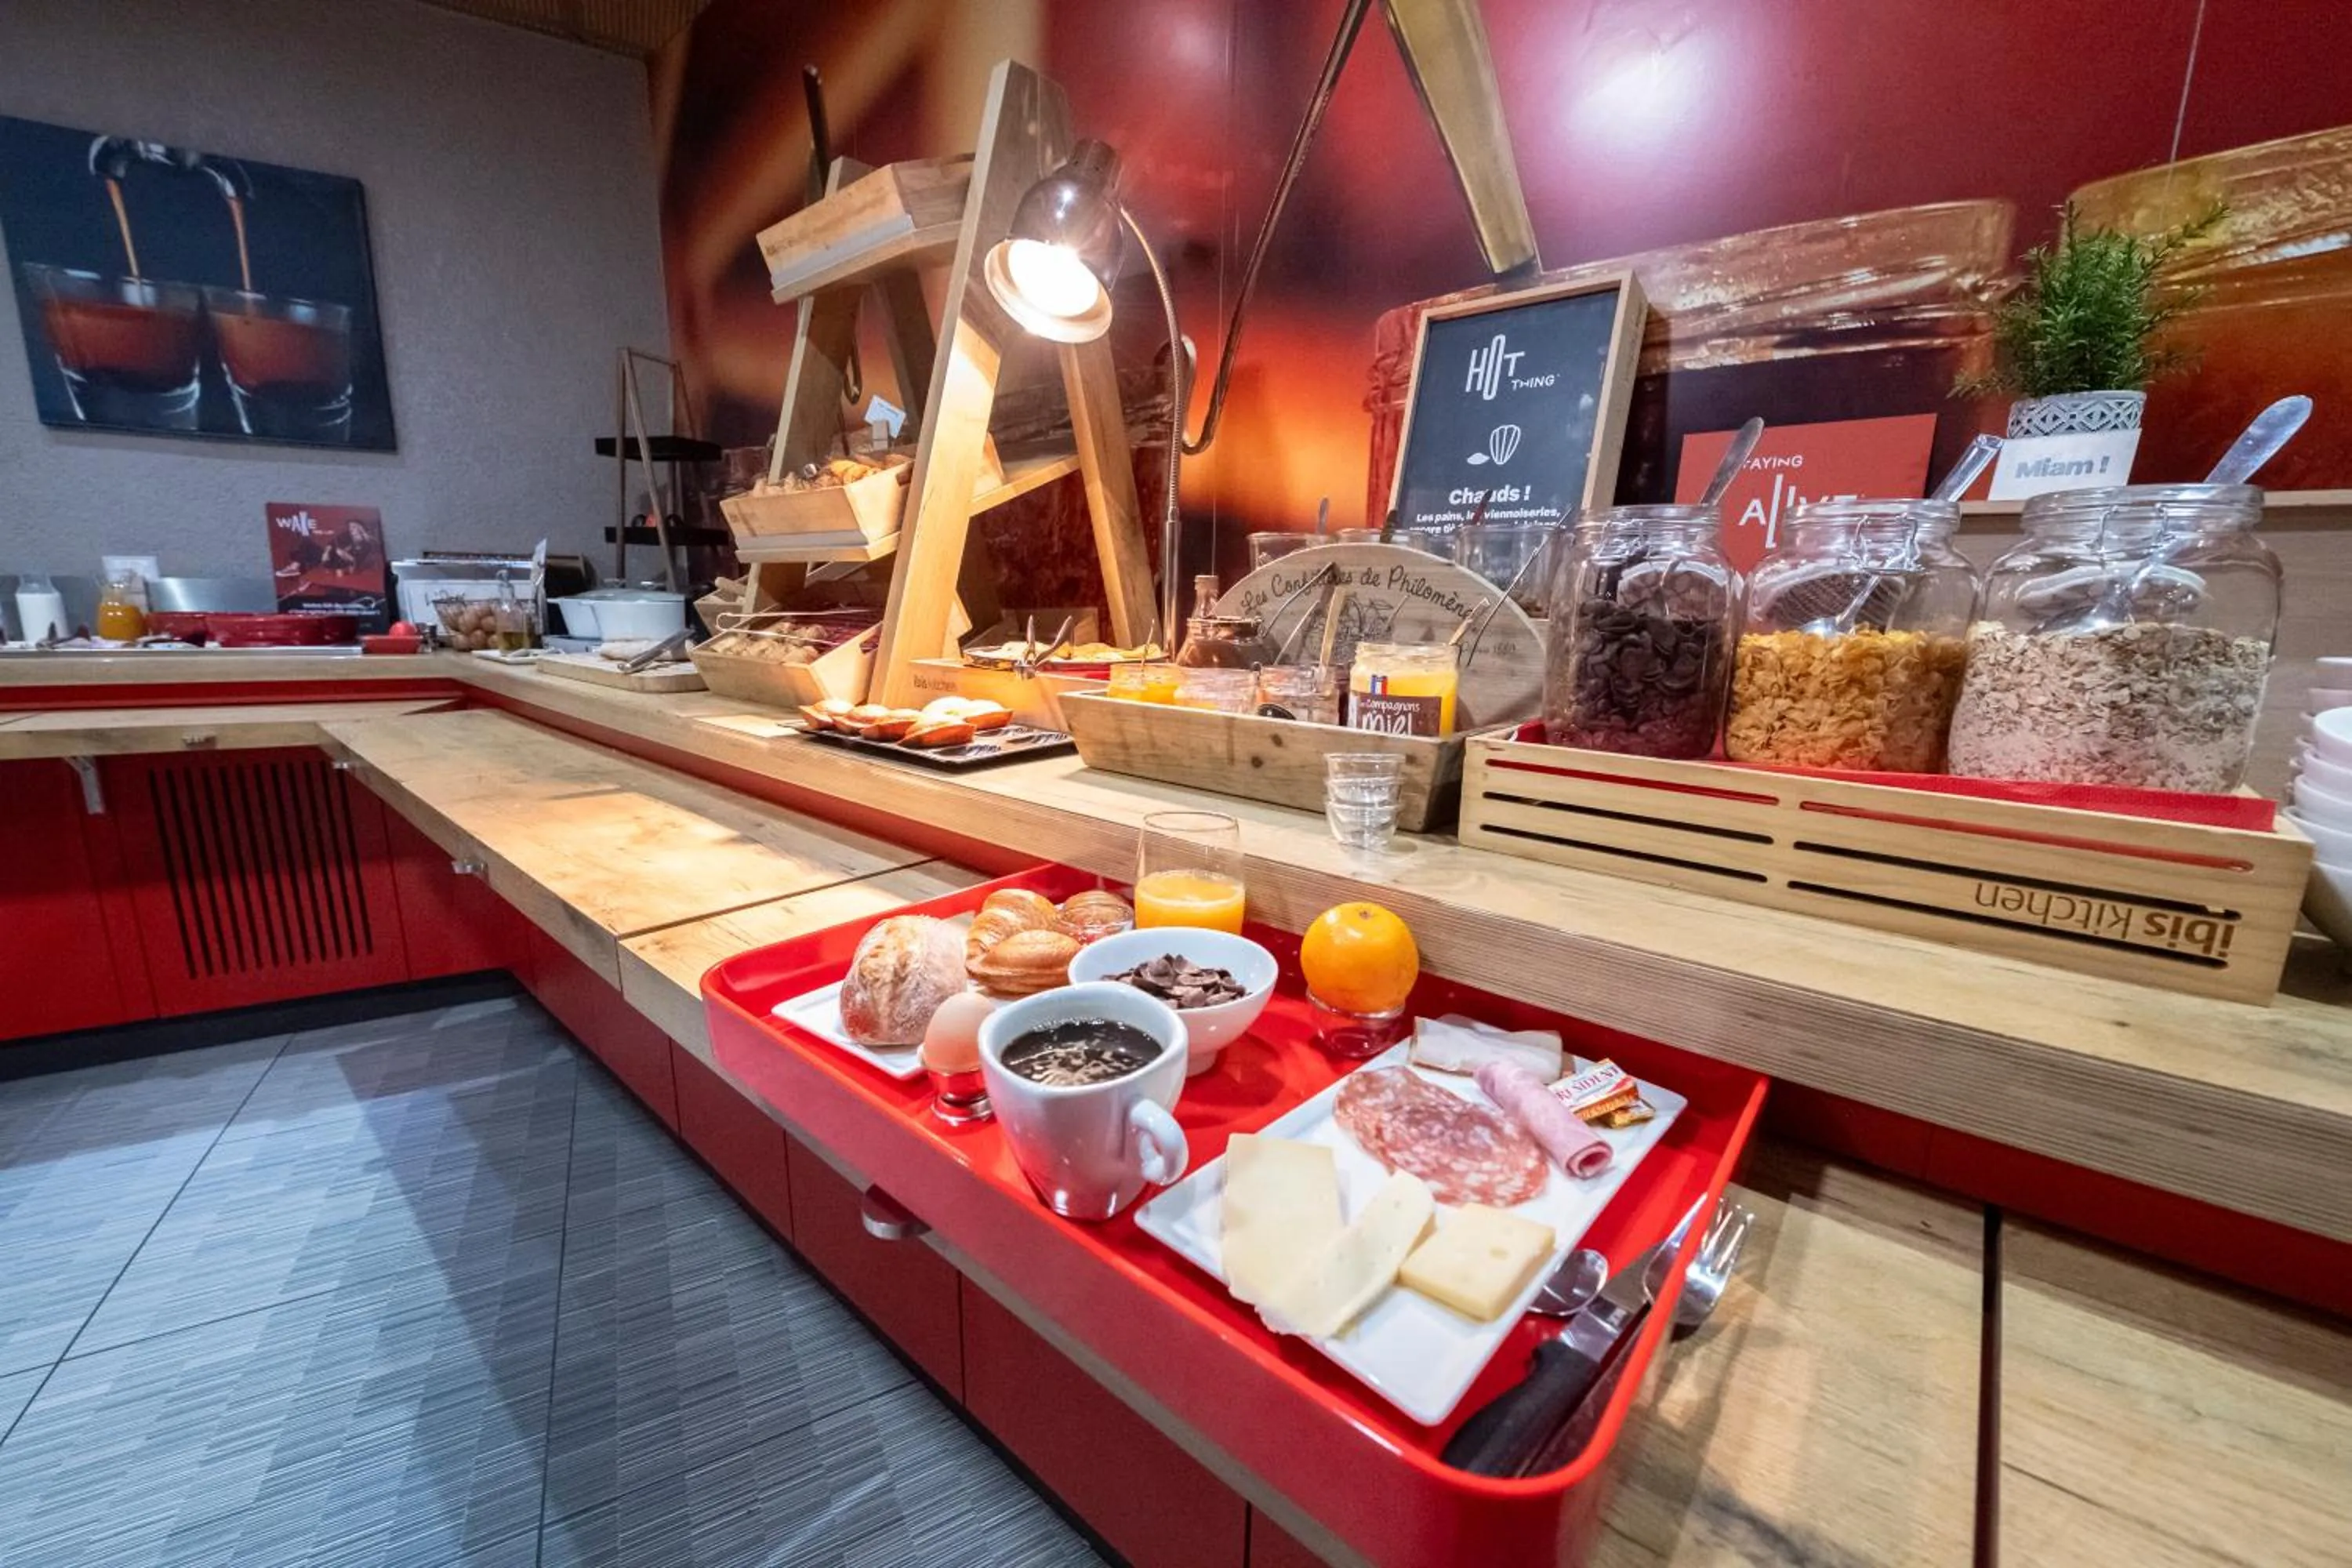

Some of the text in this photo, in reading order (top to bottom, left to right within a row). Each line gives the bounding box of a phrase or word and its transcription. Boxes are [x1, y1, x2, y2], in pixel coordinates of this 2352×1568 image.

[1465, 334, 1526, 401] HOT
[1511, 374, 1555, 390] THING
[1743, 455, 1803, 470] TAYING
[2015, 457, 2094, 478] Miam
[1360, 567, 1381, 587] de
[1974, 882, 2235, 957] ibis kitchen
